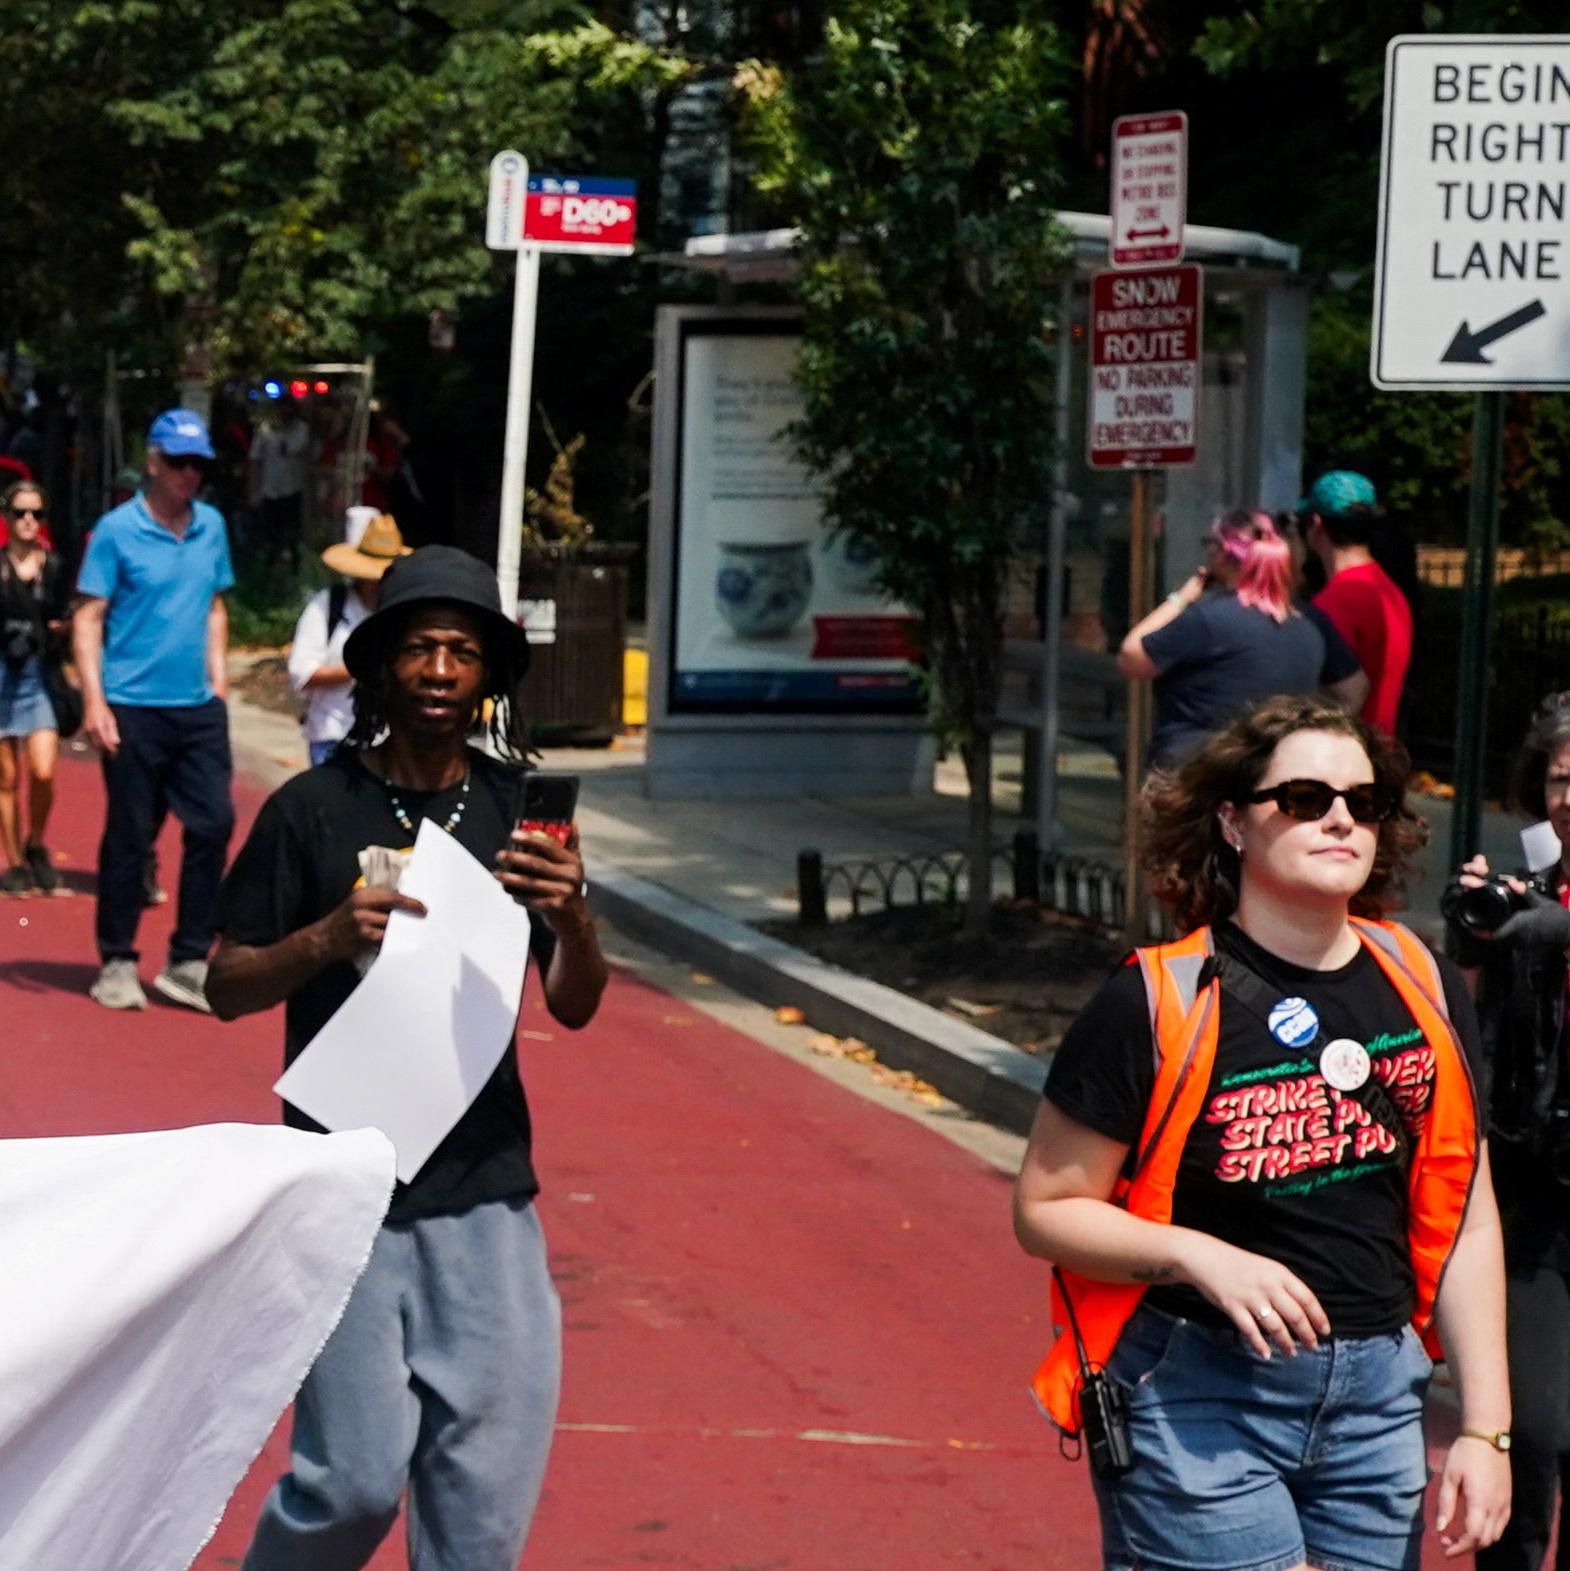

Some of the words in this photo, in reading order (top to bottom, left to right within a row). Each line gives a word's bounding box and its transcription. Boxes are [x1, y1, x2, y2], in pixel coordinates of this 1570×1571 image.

[1434, 63, 1570, 104] BEGIN
[1430, 121, 1570, 163] RIGHT
[1436, 181, 1565, 222] TURN
[1431, 239, 1562, 280] LANE
[1111, 275, 1182, 309] SNOW
[1096, 304, 1195, 332] EMERGENCY
[1103, 329, 1188, 362] ROUTE
[1097, 368, 1121, 392] NO
[1127, 361, 1192, 389] PARKING
[1115, 392, 1174, 419] DURING
[1096, 420, 1192, 448] EMERGENCY
[1205, 1074, 1327, 1124] STRIKE
[1220, 1106, 1332, 1150] STATE
[1214, 1133, 1352, 1183] STREET
